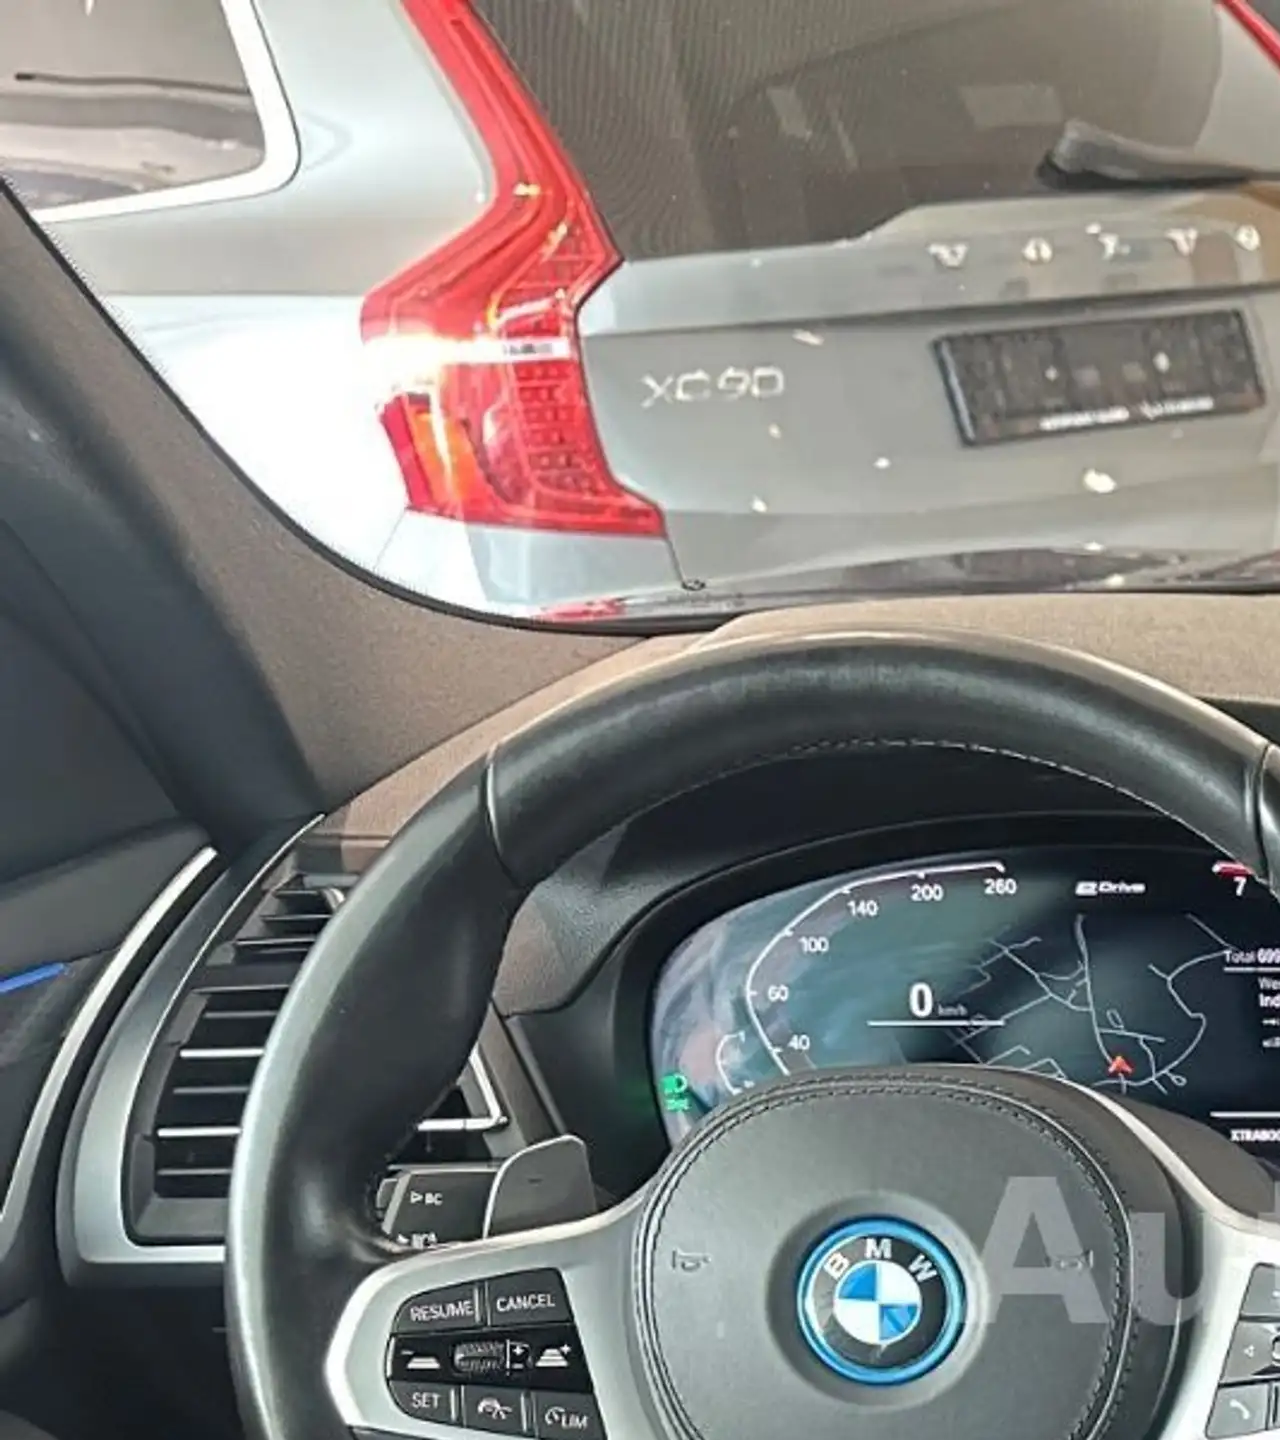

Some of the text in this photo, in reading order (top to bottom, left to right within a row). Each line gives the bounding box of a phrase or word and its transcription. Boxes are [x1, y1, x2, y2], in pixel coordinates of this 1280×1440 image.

[911, 884, 944, 902] 200
[983, 877, 1017, 895] 260
[1234, 877, 1247, 897] 7
[847, 900, 879, 917] 140
[799, 937, 829, 953] 100
[1224, 949, 1256, 965] Total
[768, 986, 789, 1002] 60
[909, 983, 933, 1017] 0
[787, 1034, 811, 1050] 40
[823, 1237, 937, 1283] BMW
[410, 1299, 474, 1322] RESUME
[496, 1293, 555, 1313] CANCEL
[411, 1391, 441, 1409] SET
[561, 1413, 588, 1430] LIM
